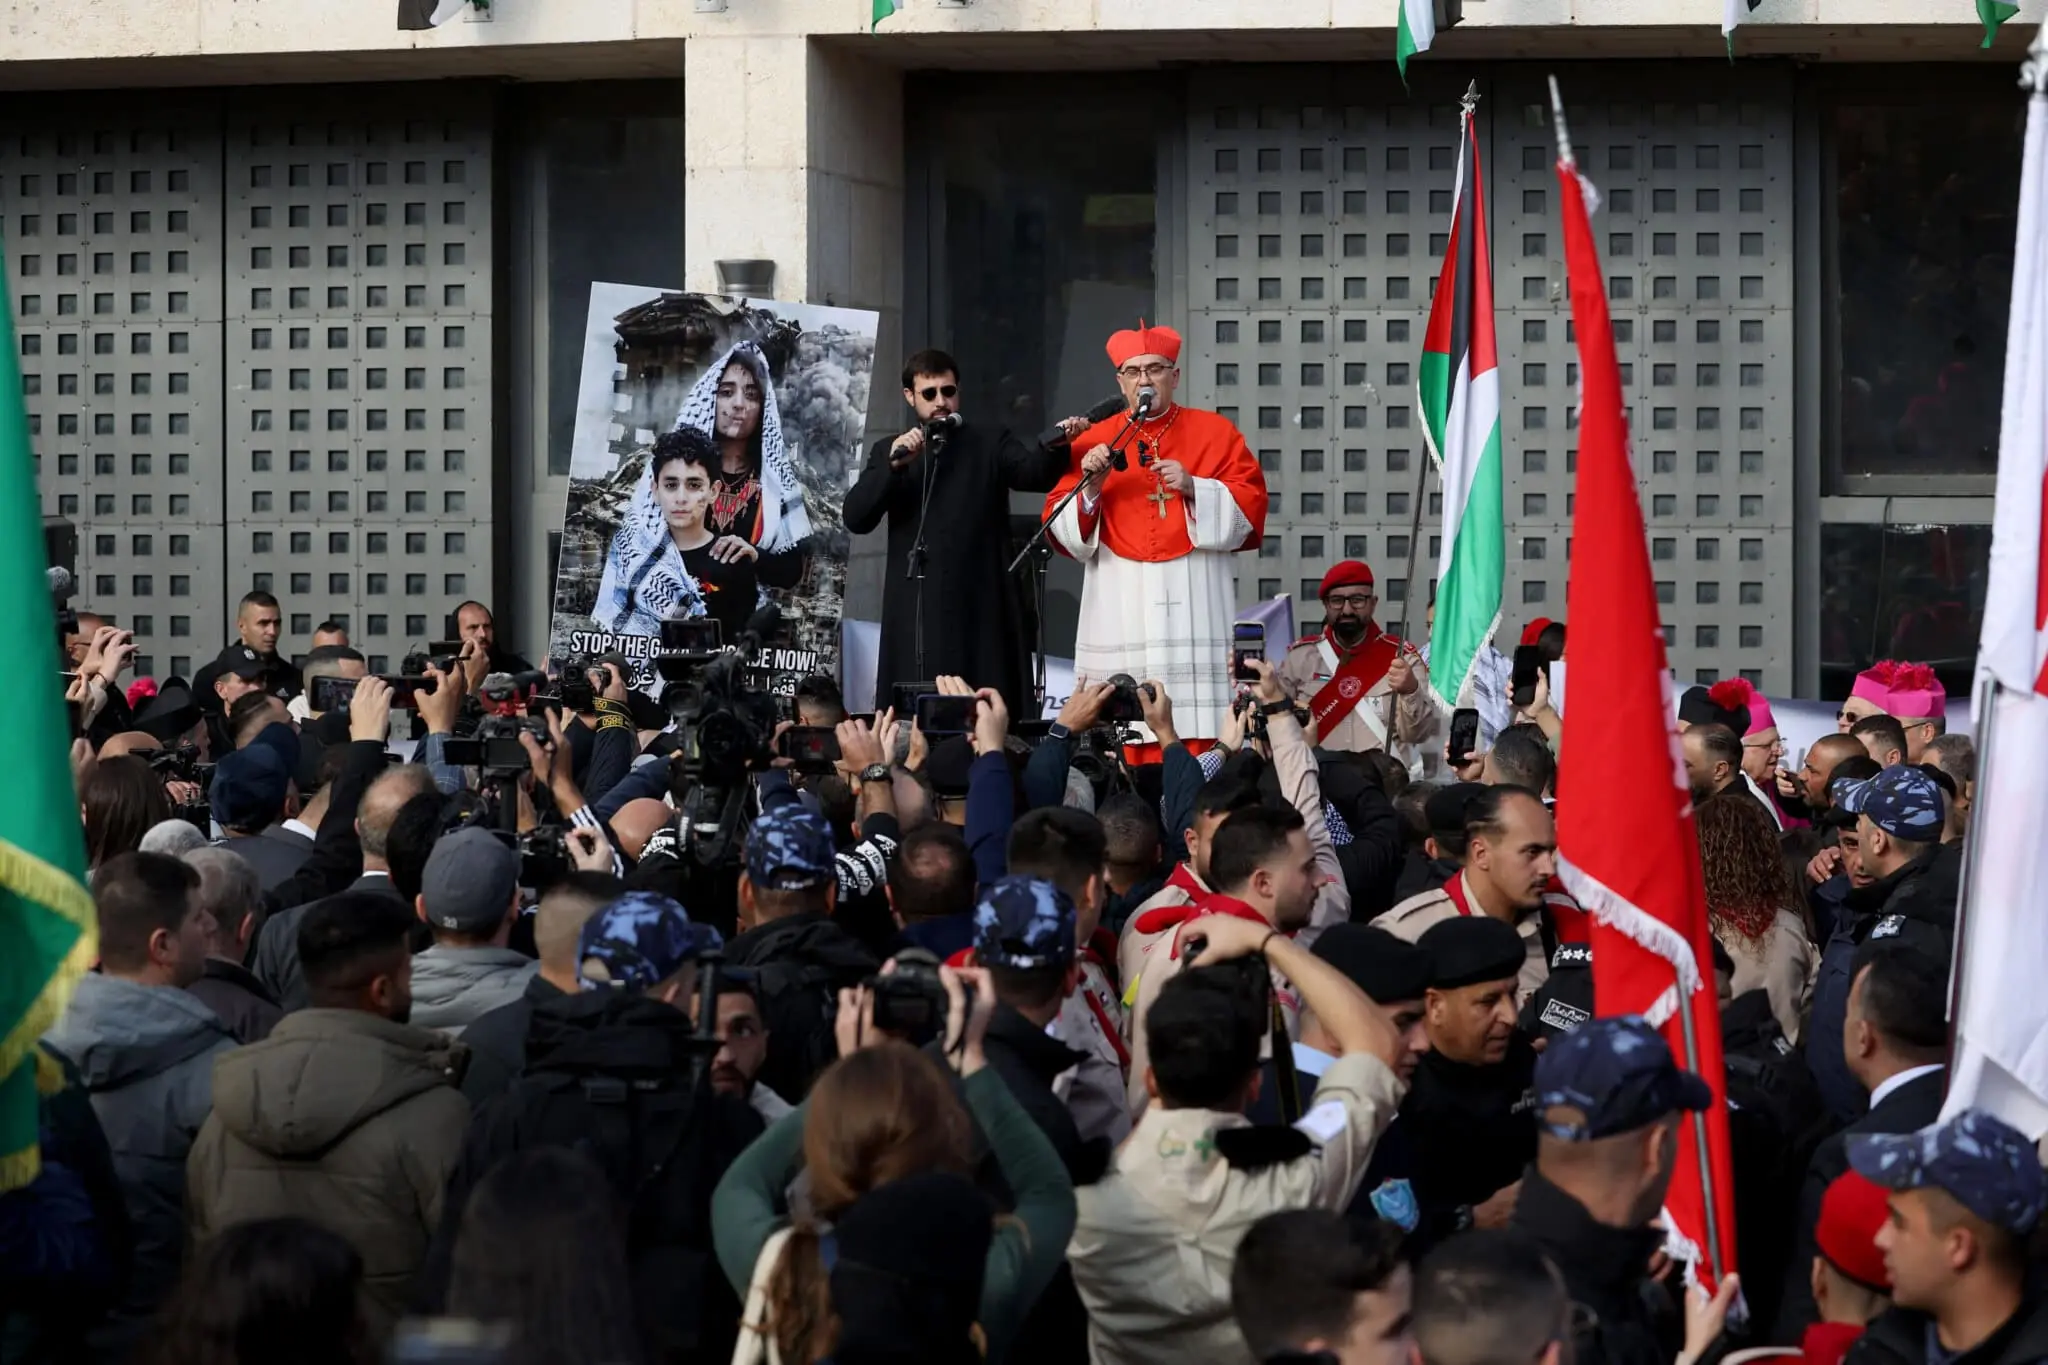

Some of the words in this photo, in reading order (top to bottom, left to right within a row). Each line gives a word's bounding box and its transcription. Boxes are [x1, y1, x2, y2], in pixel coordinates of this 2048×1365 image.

[571, 631, 612, 654] STOP
[616, 635, 646, 658] THE
[774, 648, 817, 672] NOW!
